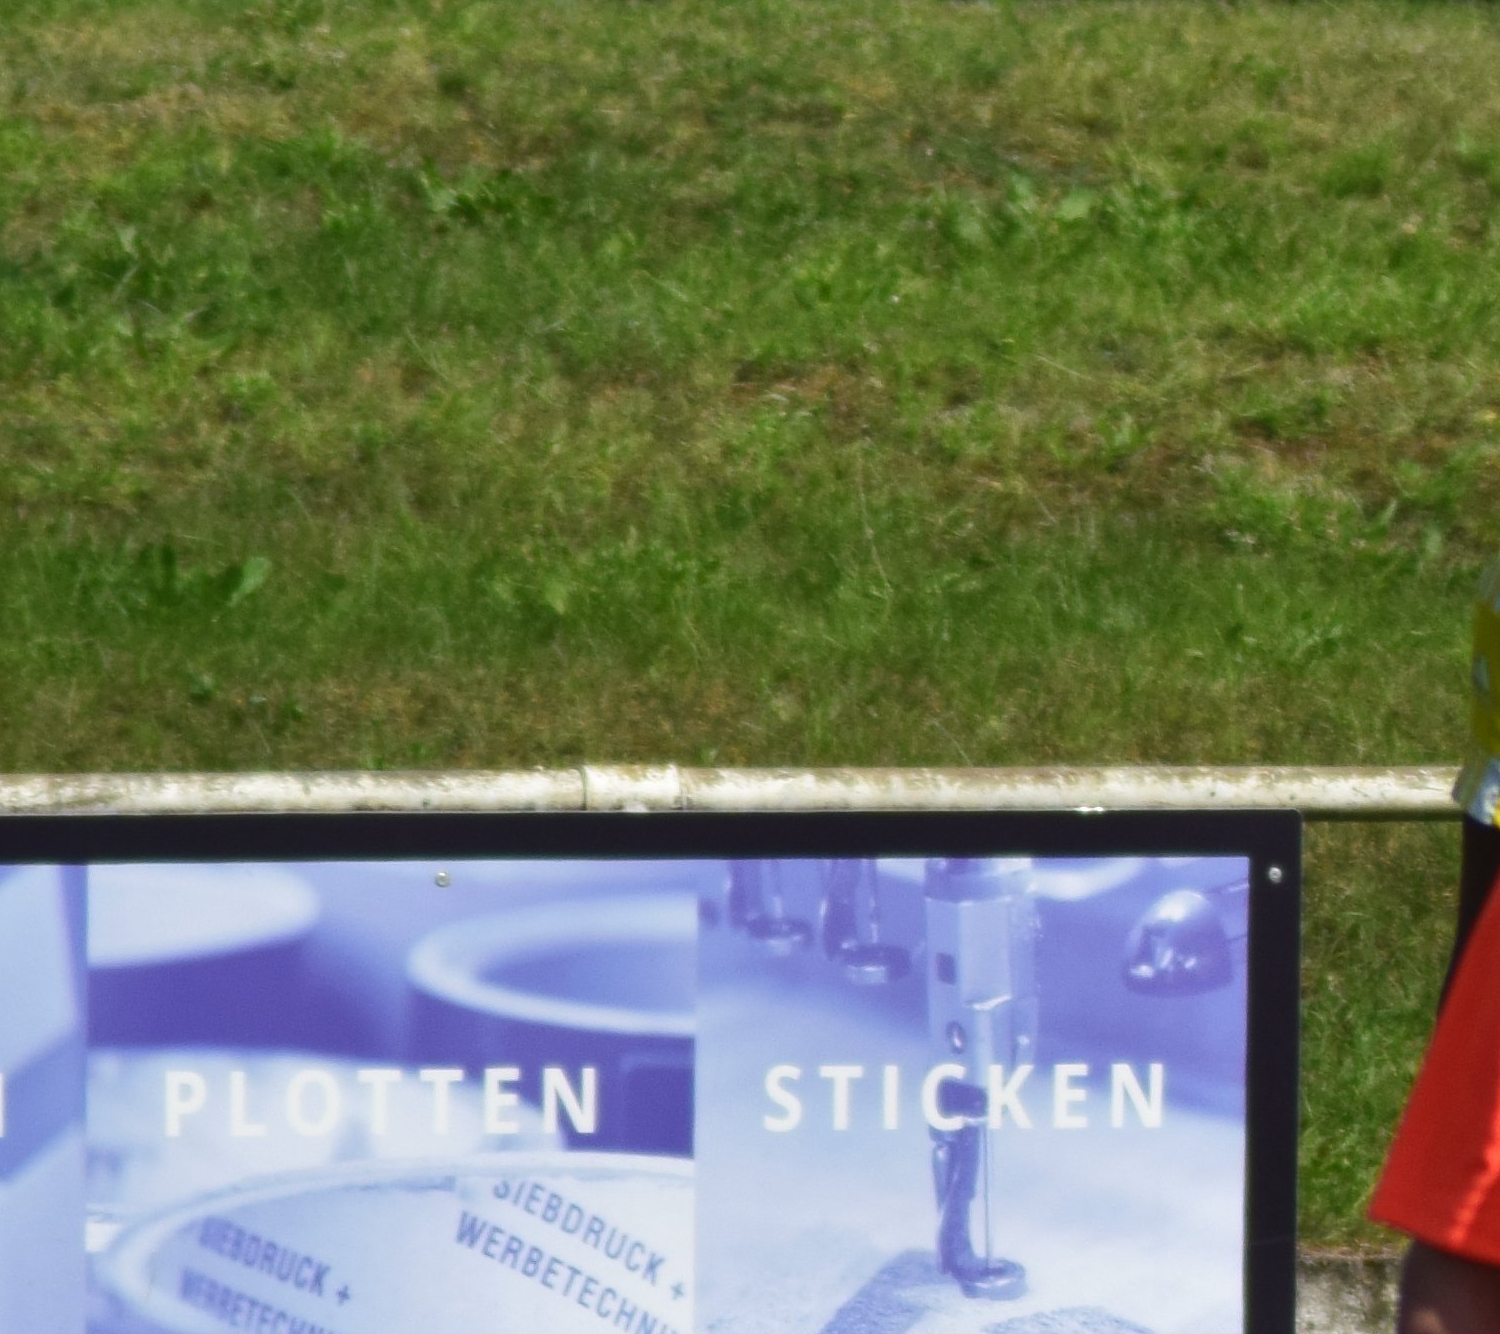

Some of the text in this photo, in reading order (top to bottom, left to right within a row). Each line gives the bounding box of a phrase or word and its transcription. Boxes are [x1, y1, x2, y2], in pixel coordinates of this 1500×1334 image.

[164, 1067, 599, 1139] PLOTTEN
[762, 1062, 1165, 1133] STICKEN
[493, 1178, 665, 1285] SIEBDRUCK
